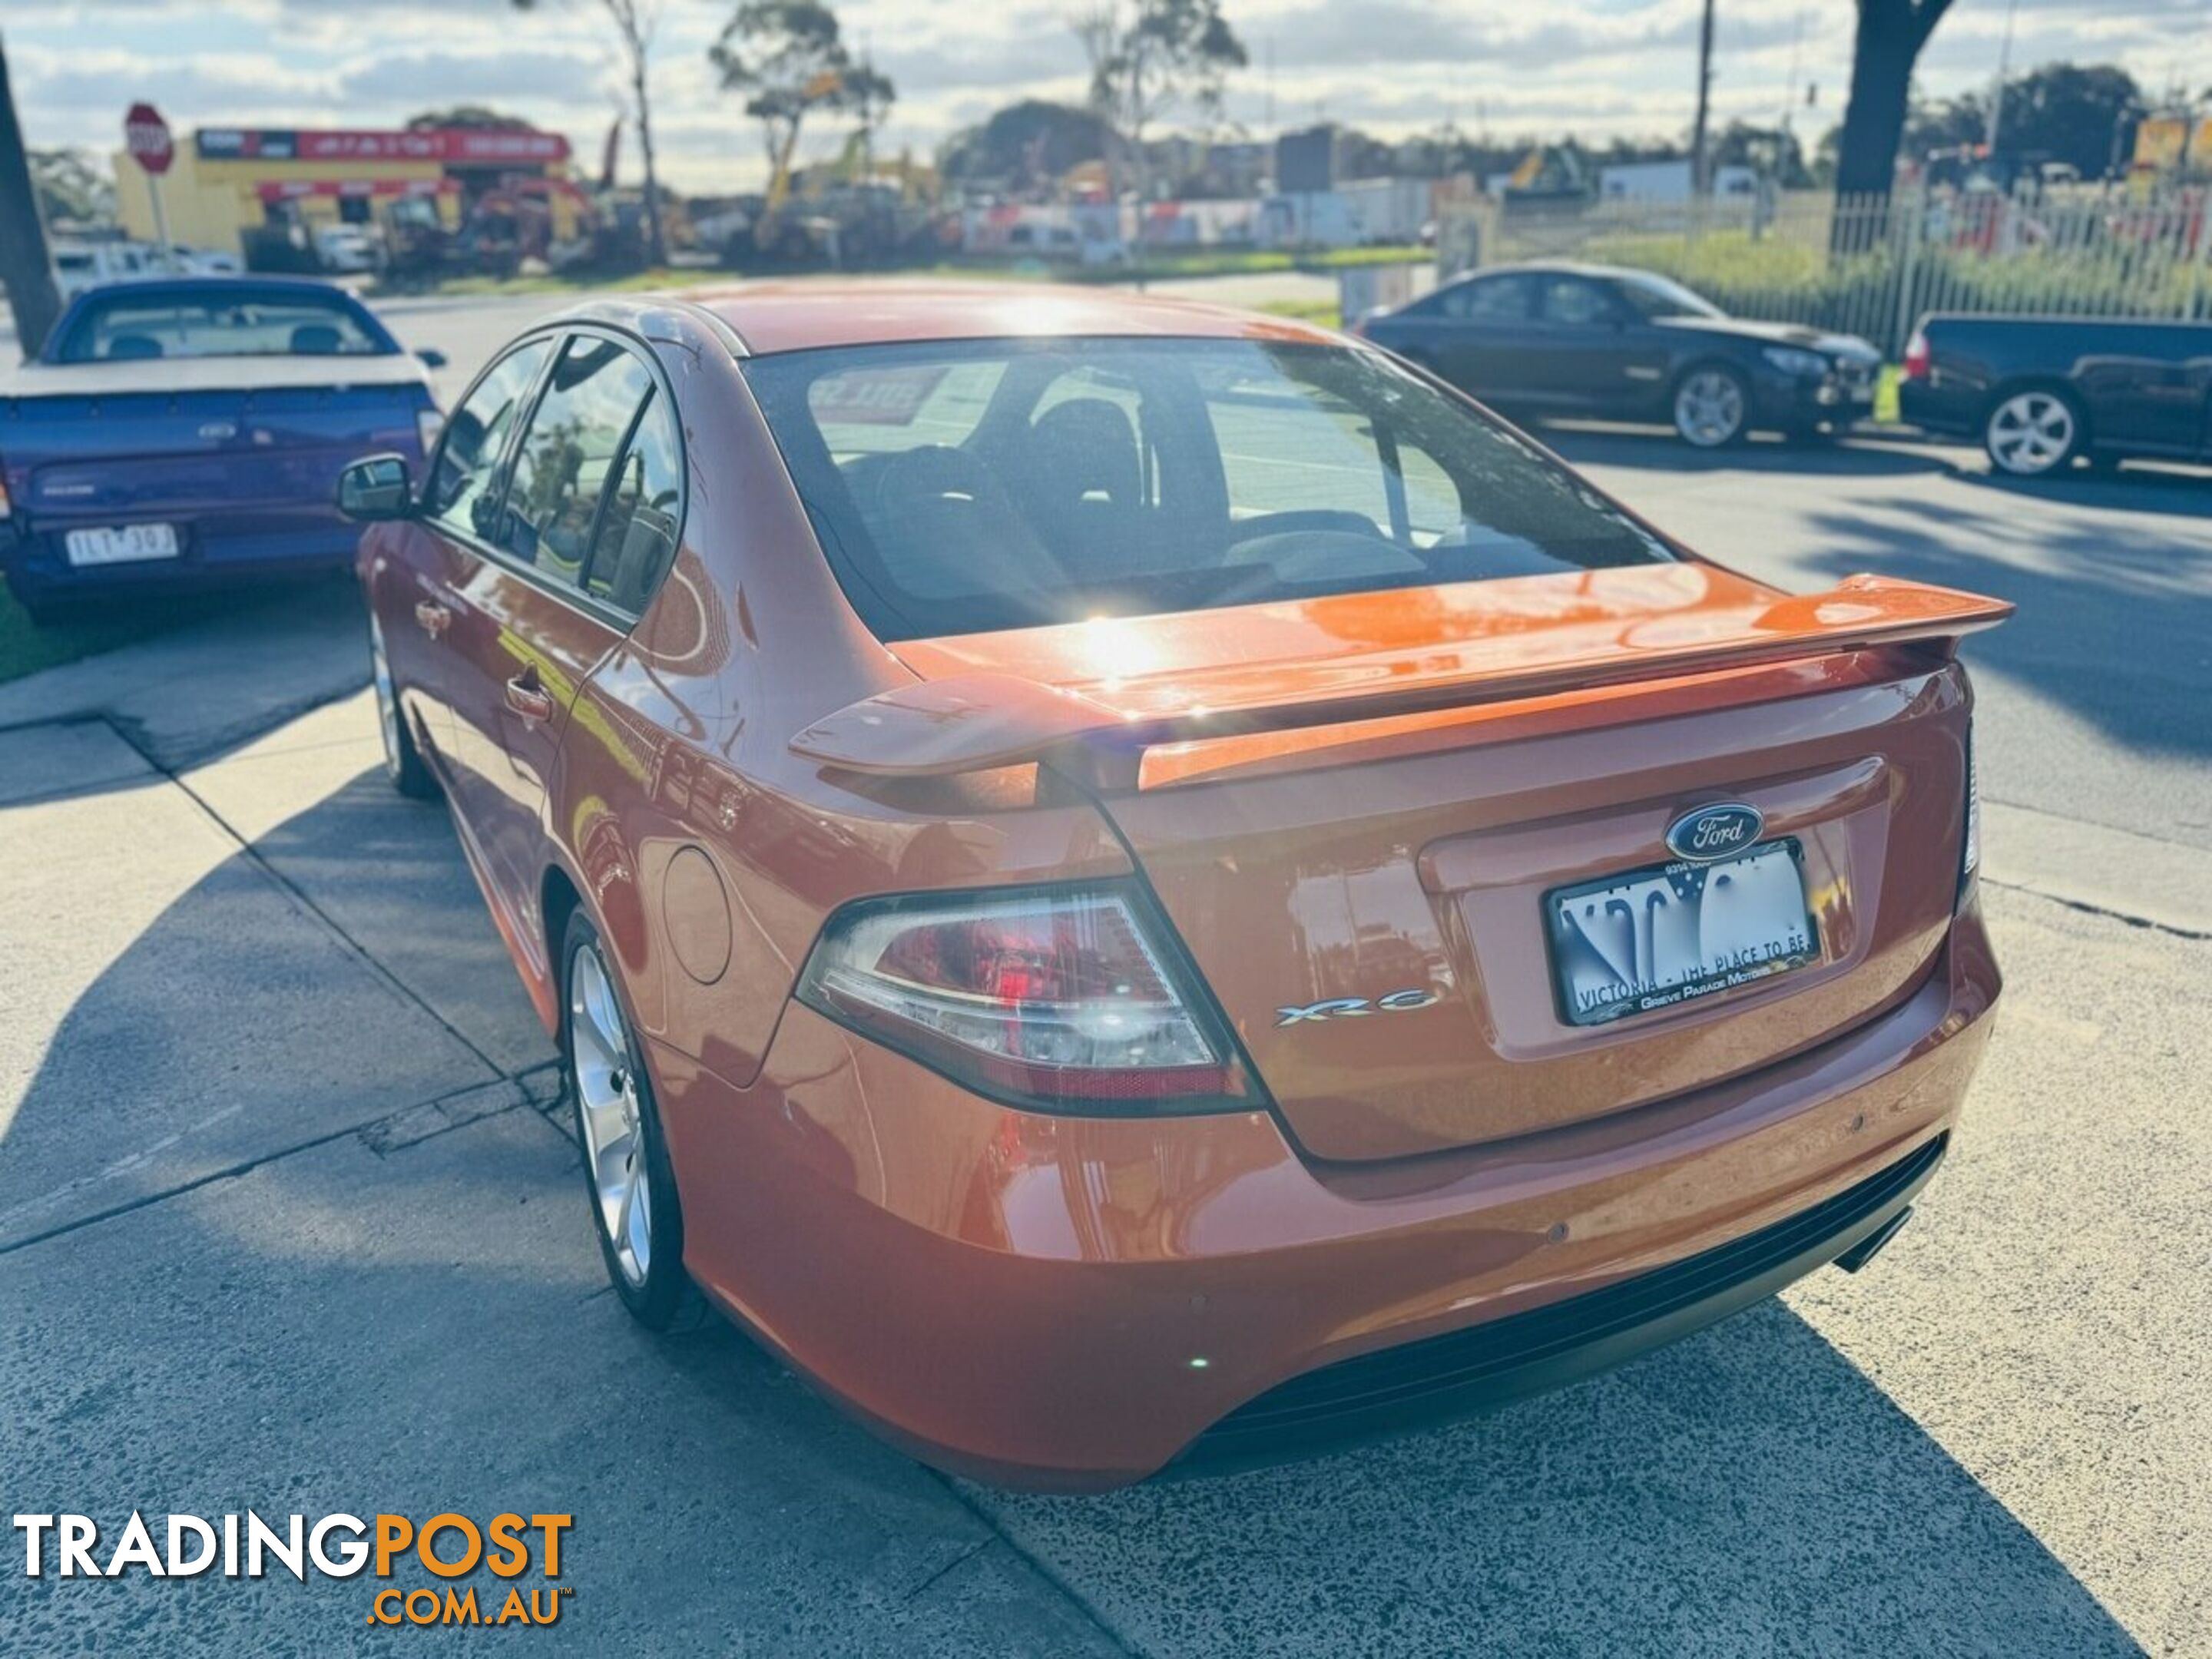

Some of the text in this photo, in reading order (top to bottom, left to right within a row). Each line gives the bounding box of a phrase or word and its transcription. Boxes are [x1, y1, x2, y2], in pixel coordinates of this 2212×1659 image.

[1693, 815, 1743, 849] Ford
[1580, 979, 1658, 1009] VICTORIA
[1715, 947, 1757, 974] PLACE
[1764, 940, 1783, 958] TO
